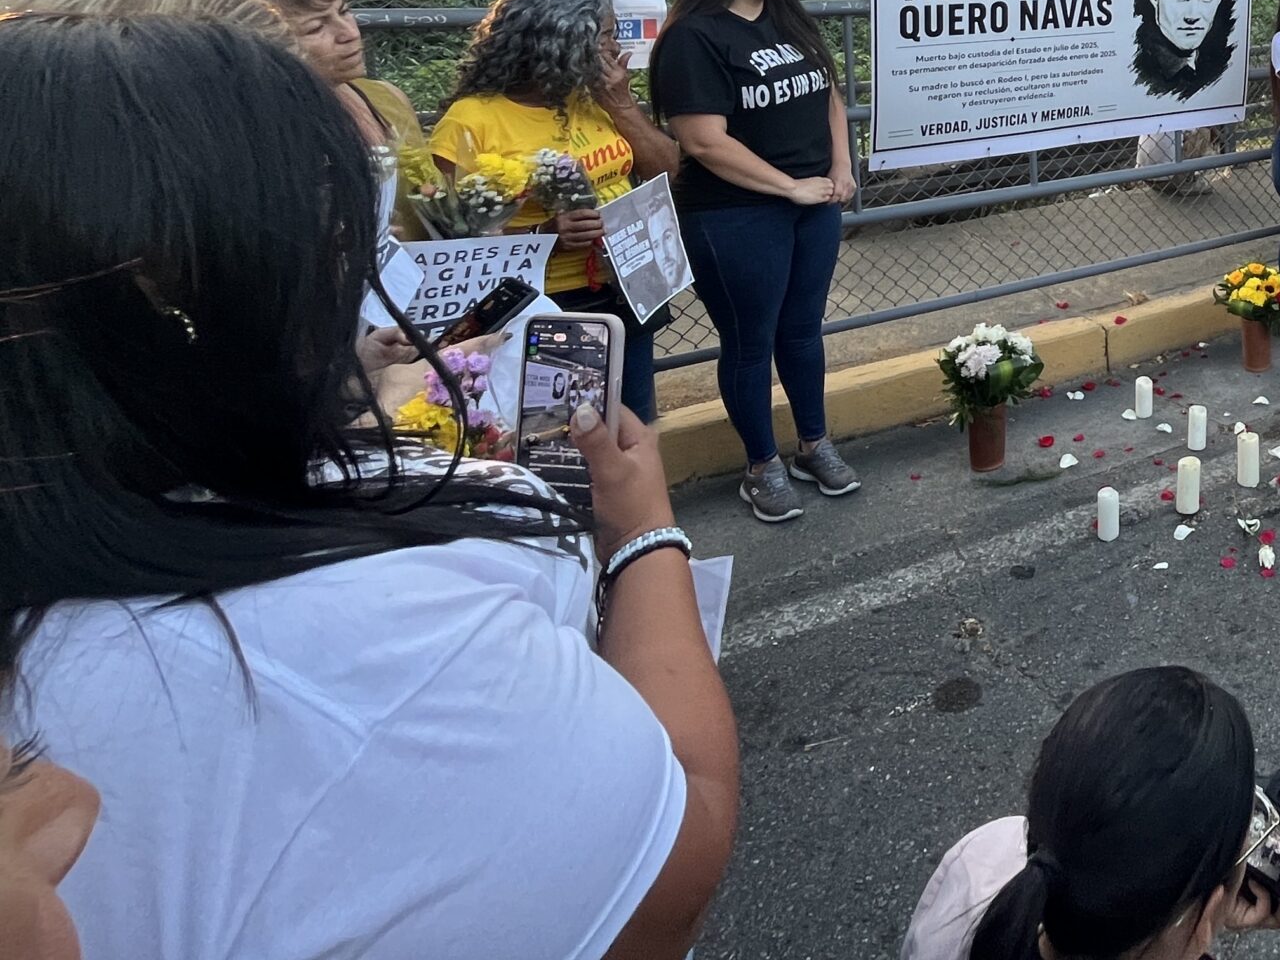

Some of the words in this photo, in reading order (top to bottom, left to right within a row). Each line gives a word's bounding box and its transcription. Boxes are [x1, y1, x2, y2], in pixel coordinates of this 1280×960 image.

[899, 1, 1009, 42] QUERO
[915, 55, 946, 63] Muerto
[948, 52, 966, 61] bajo
[967, 49, 1000, 58] custodia
[1016, 47, 1041, 55] Estado
[1053, 44, 1069, 53] julio
[891, 69, 908, 77] tras
[909, 65, 956, 76] permanecer
[969, 57, 1017, 69] desaparición
[1018, 56, 1046, 65] forzada
[741, 84, 770, 109] NO
[773, 78, 791, 105] ES
[791, 73, 810, 98] UN
[908, 85, 919, 93] Su
[921, 83, 948, 92] madre
[960, 79, 984, 88] buscó
[997, 75, 1023, 84] Rodeo
[1030, 74, 1048, 82] pero
[1061, 68, 1104, 78] autoridades
[927, 93, 962, 102] negaron
[974, 86, 1012, 96] reclusión,
[1014, 82, 1051, 92] ocultaron
[1062, 79, 1088, 87] muerte
[968, 96, 1016, 107] destruyeron
[1018, 91, 1056, 101] evidencia.
[920, 120, 972, 137] VERDAD,
[975, 113, 1028, 130] JUSTICIA
[1031, 111, 1038, 123] Y
[1040, 105, 1094, 122] MEMORIA.
[414, 246, 500, 267] ADRES
[509, 242, 541, 256] EN
[421, 257, 533, 285] GILIA
[414, 282, 469, 301] IGEN
[405, 297, 479, 322] ERDA
